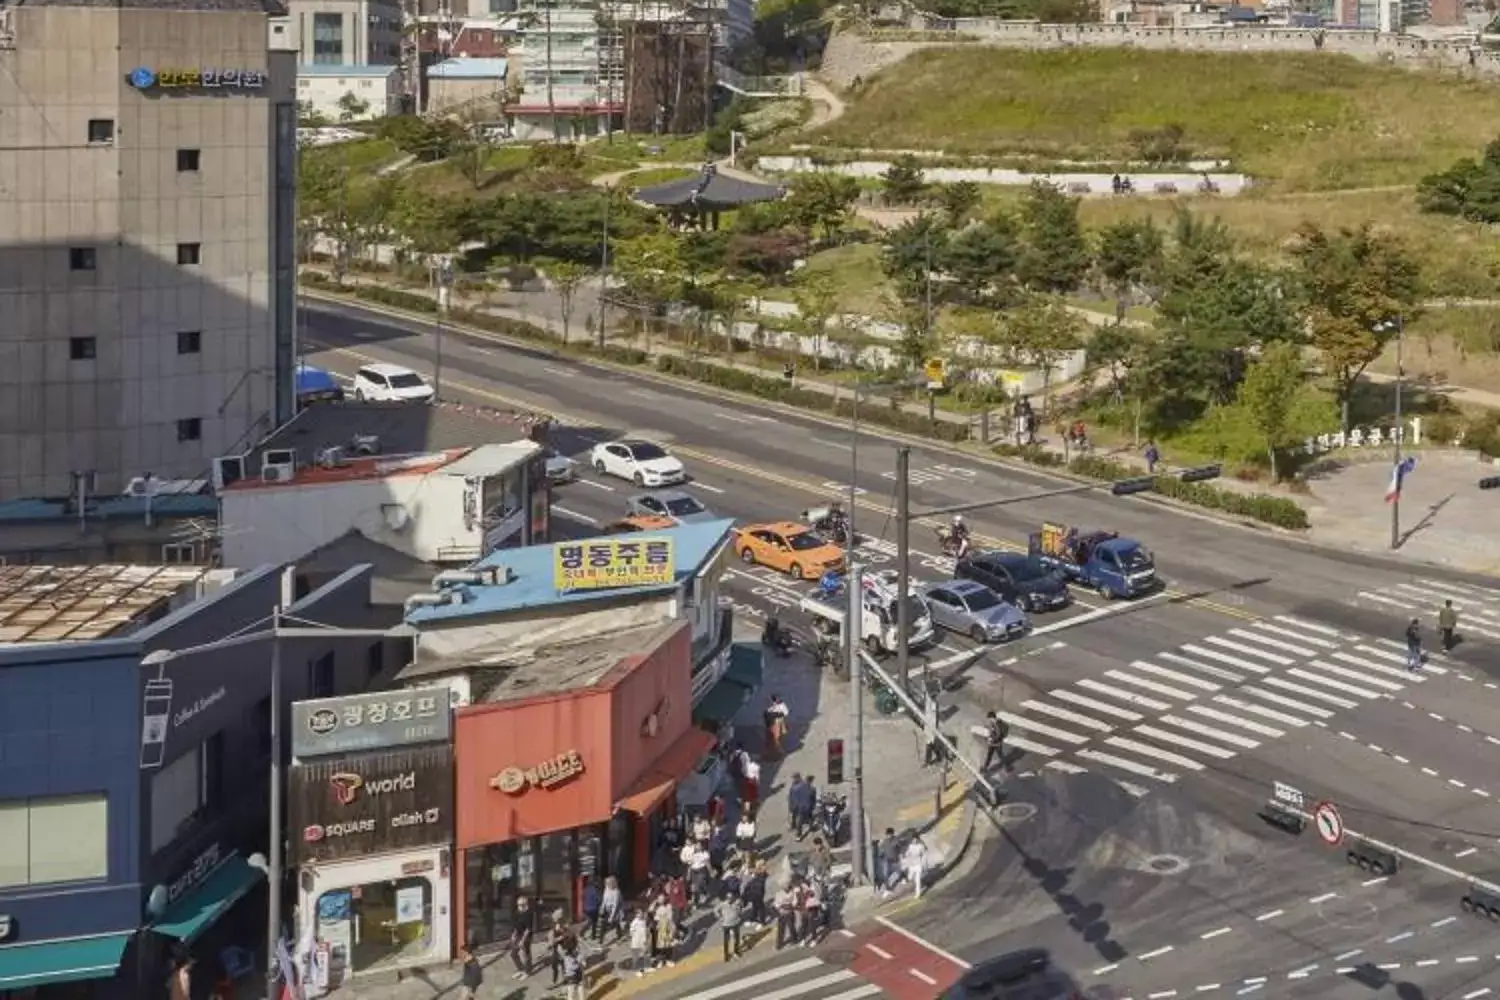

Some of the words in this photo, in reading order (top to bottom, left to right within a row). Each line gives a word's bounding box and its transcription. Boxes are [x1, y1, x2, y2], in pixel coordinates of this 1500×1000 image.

[560, 541, 668, 568] 명동주름
[343, 697, 436, 727] 광장호프
[365, 772, 416, 796] world
[325, 819, 376, 837] SQUARE
